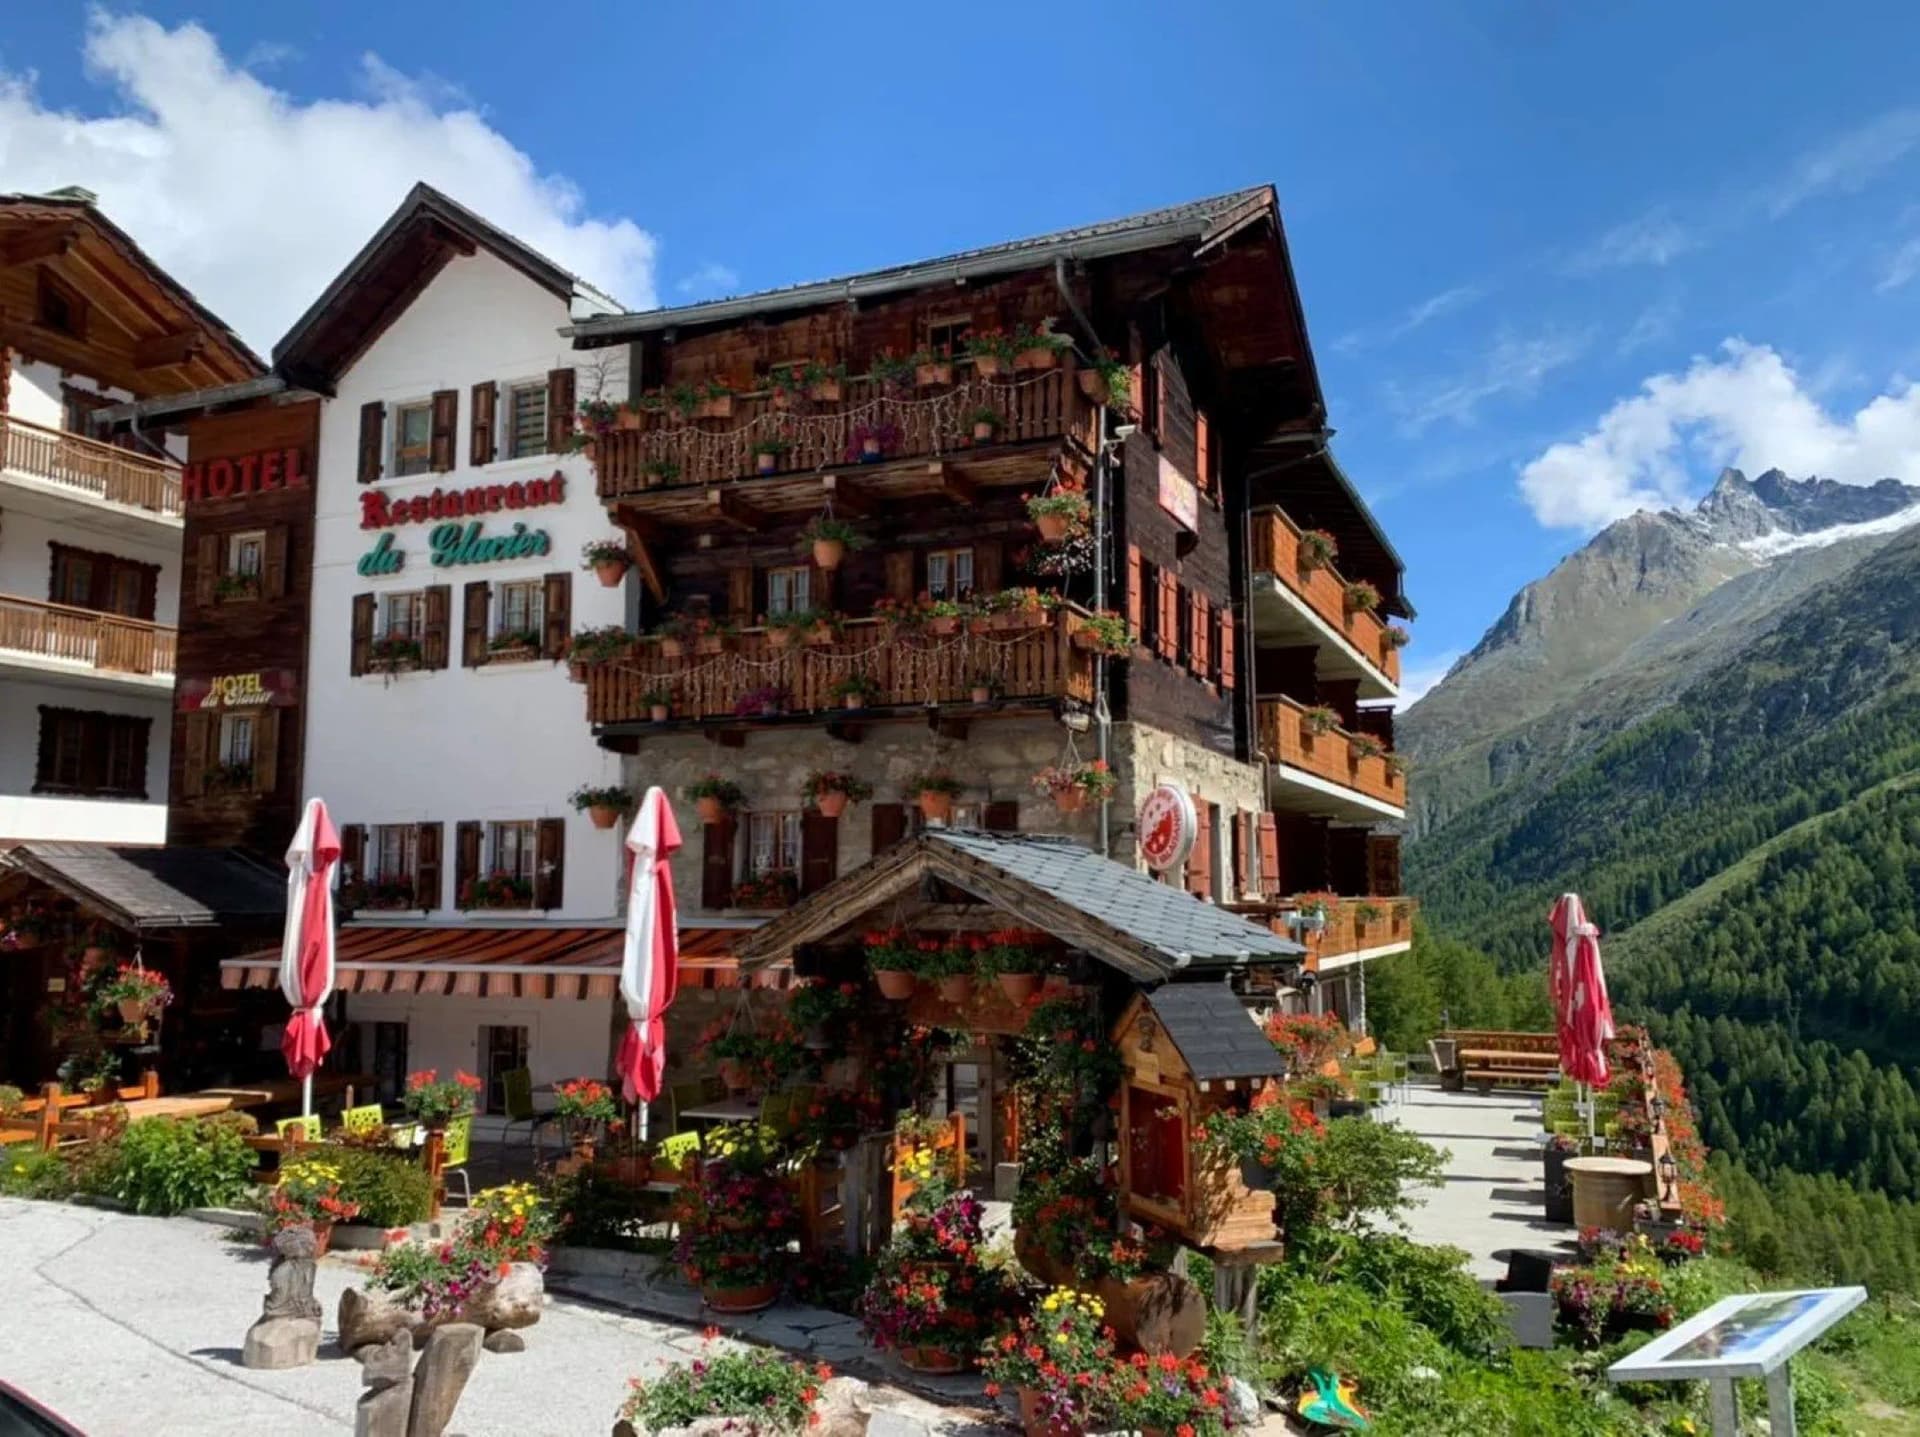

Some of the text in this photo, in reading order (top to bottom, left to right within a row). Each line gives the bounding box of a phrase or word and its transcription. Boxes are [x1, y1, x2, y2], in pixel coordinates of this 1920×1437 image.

[182, 448, 309, 502] HOTEL
[359, 470, 567, 530] Restaurant
[357, 520, 551, 577] du Glacier
[211, 673, 263, 696] HOTEL
